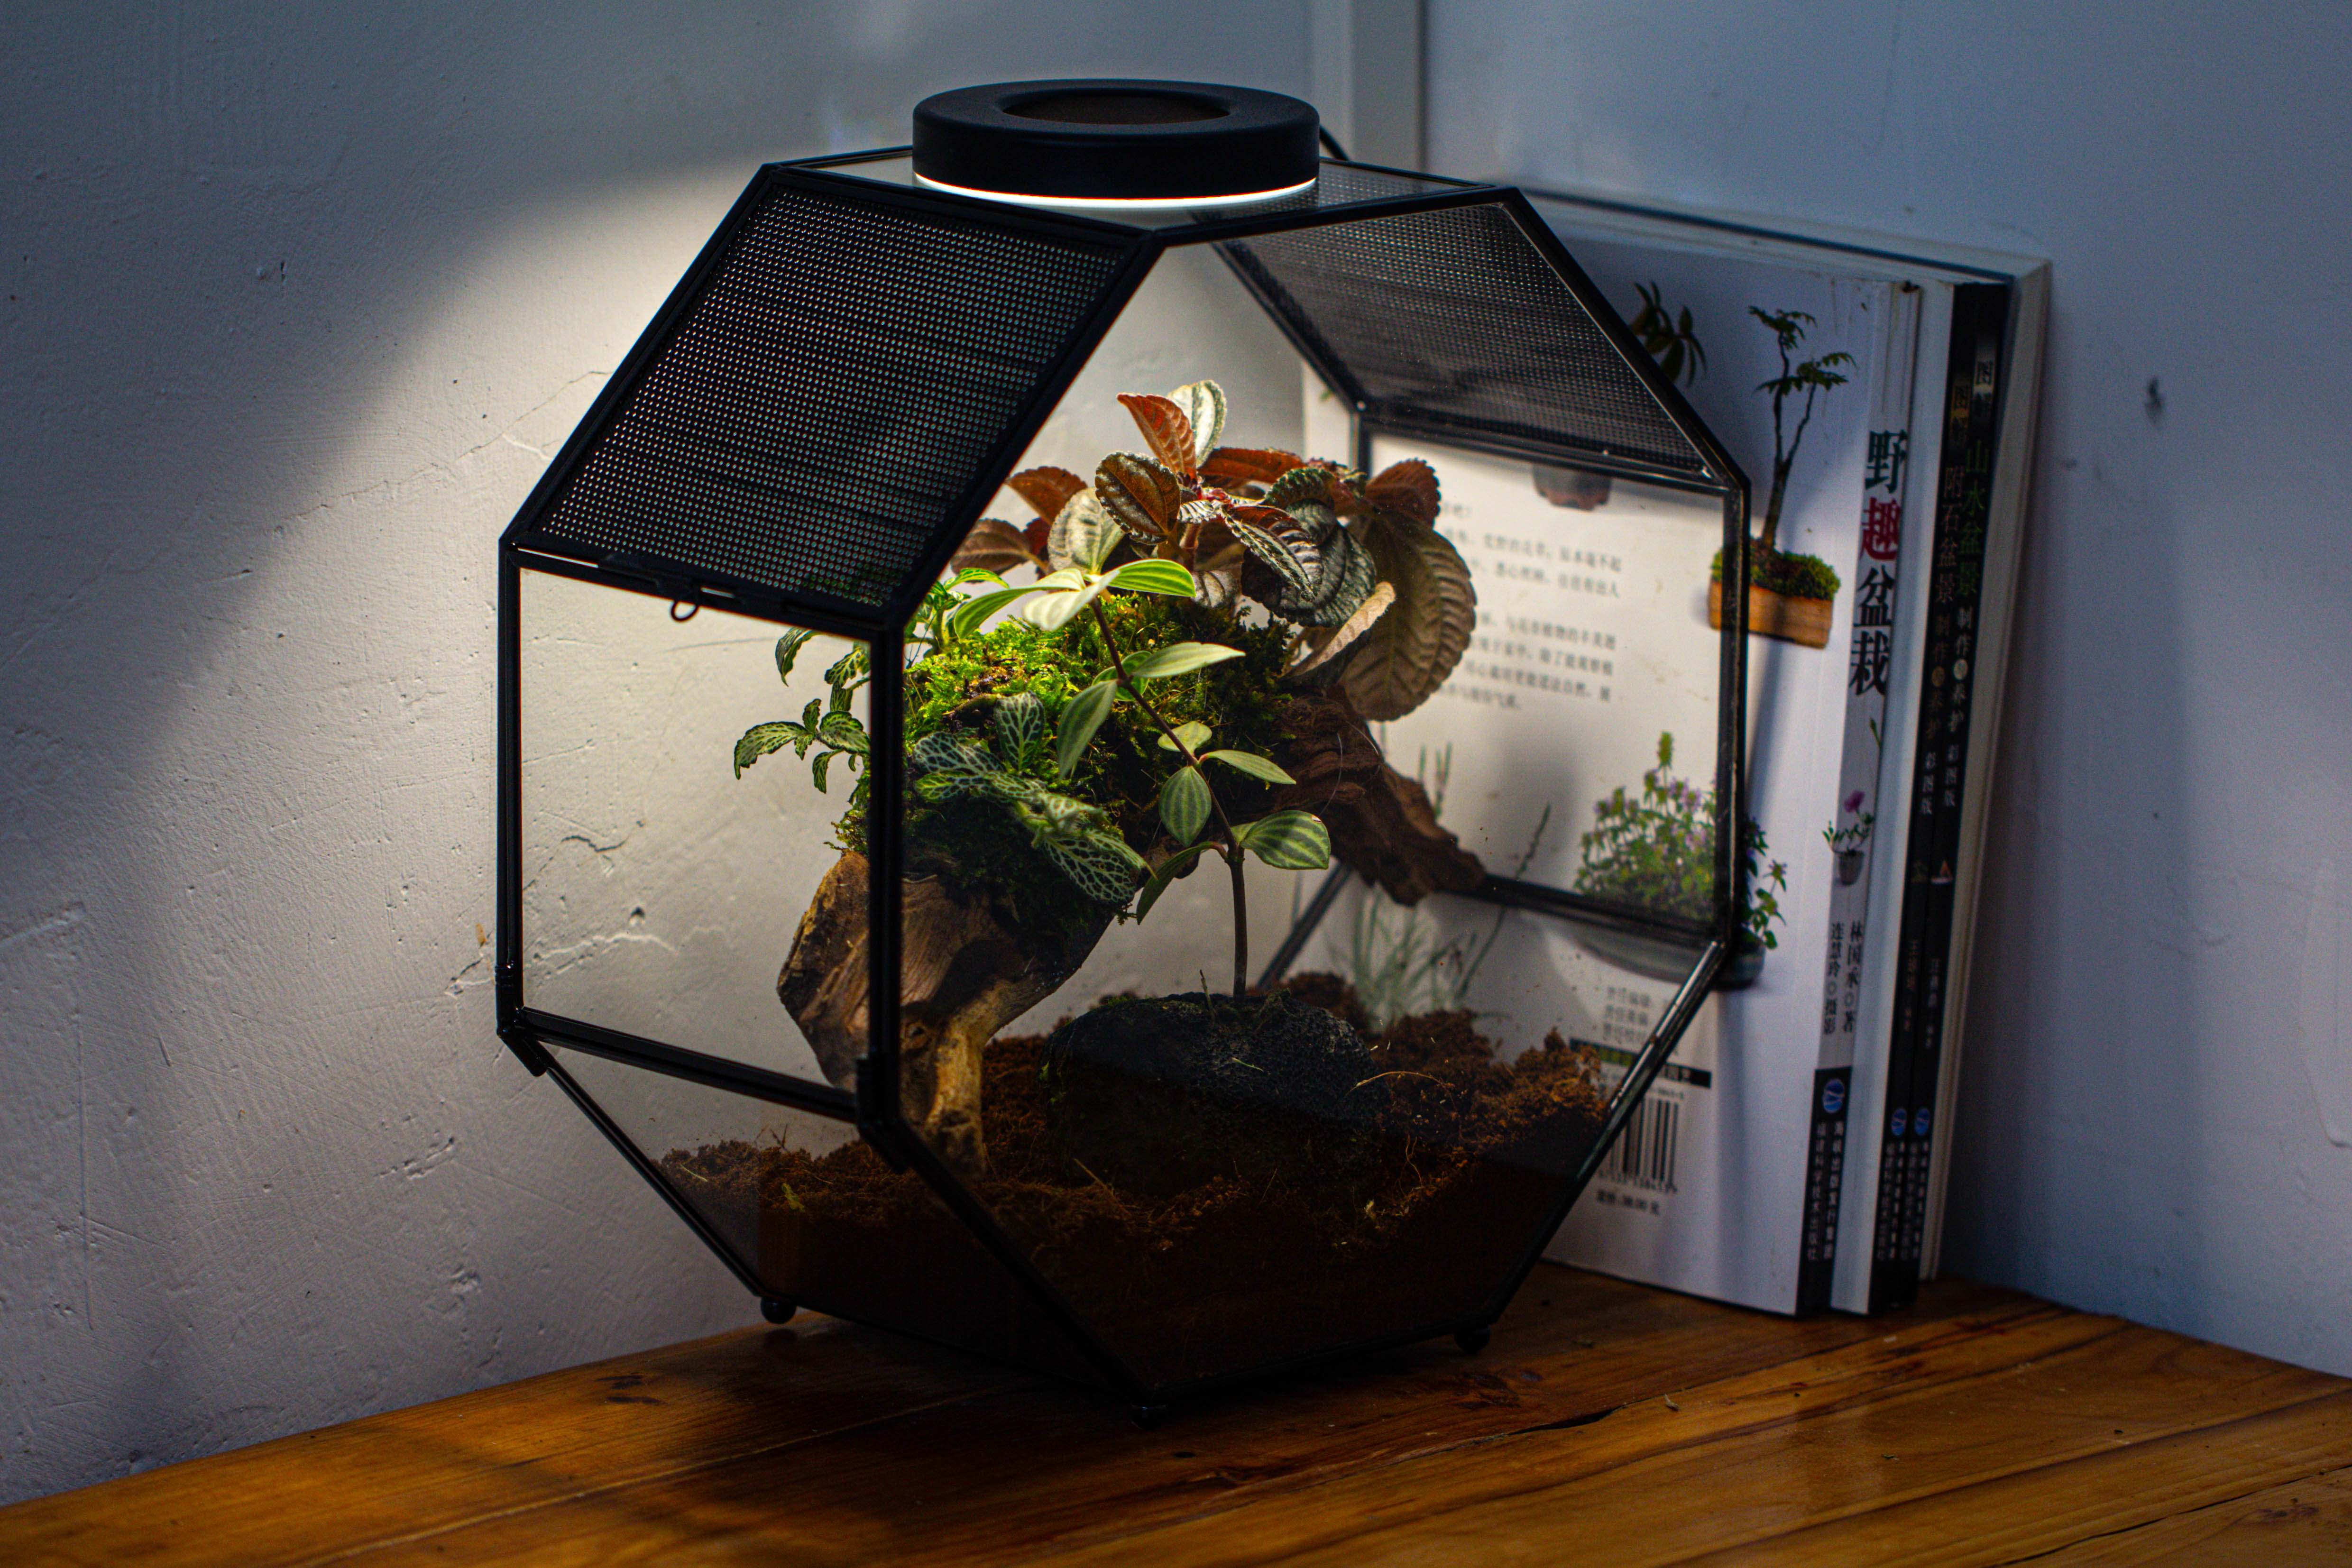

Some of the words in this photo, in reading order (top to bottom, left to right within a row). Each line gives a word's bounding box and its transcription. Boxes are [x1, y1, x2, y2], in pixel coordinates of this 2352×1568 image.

[1849, 430, 1907, 696] 野趣盆栽
[1937, 467, 1963, 604] 附石盆景
[1955, 440, 1989, 596] 山水盆景
